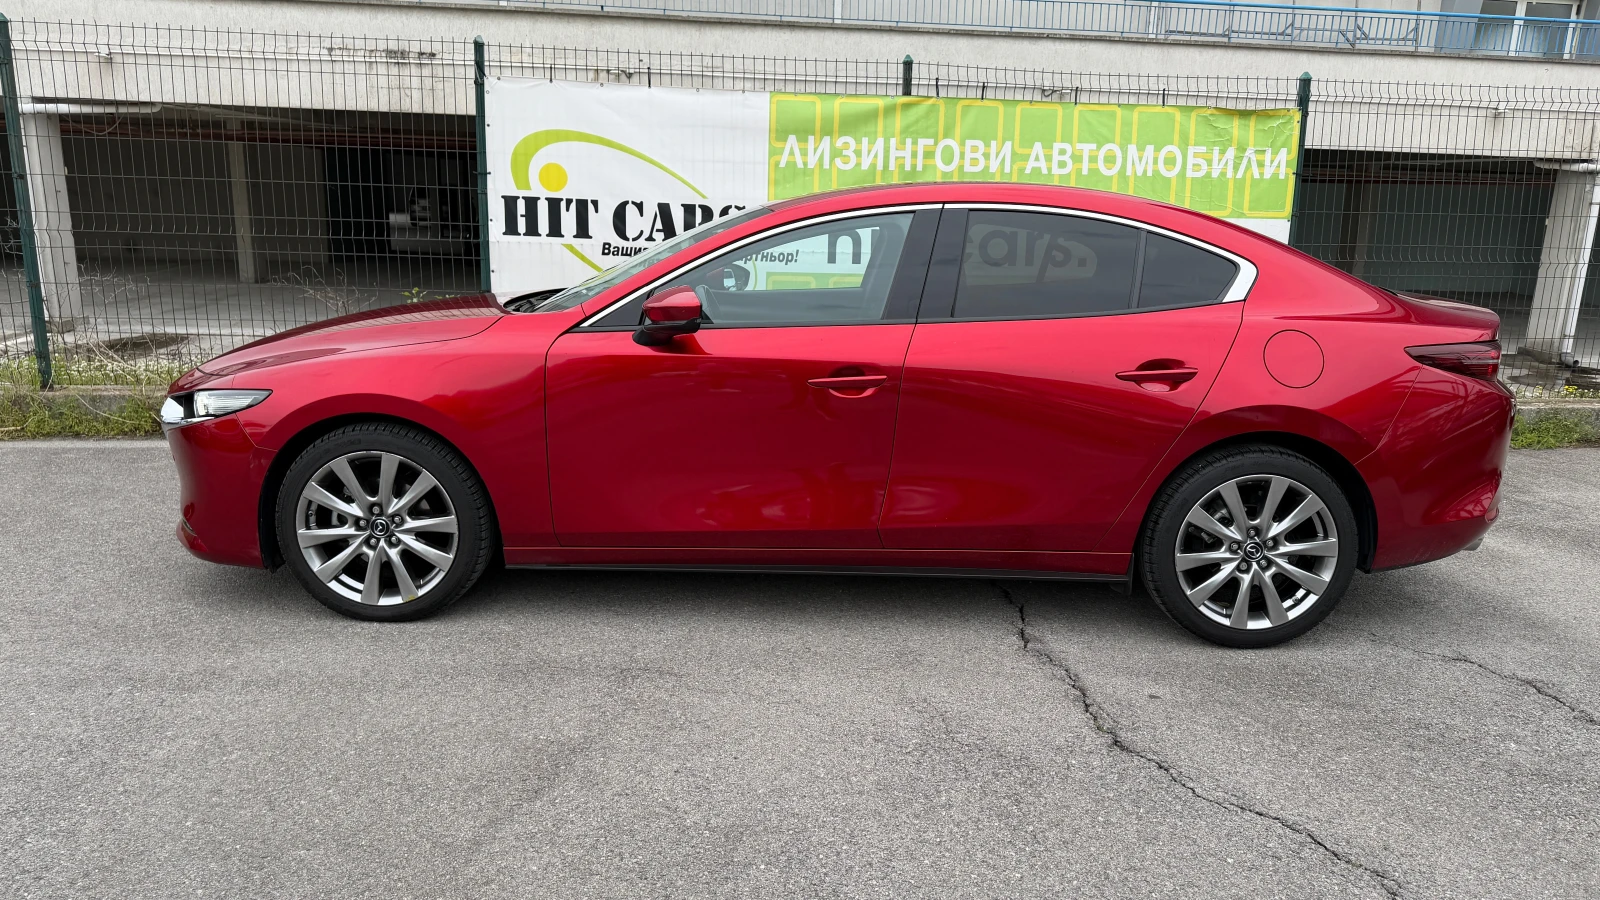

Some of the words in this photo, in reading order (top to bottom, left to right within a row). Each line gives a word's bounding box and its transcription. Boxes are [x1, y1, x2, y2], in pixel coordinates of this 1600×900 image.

[779, 134, 1012, 174] ЛИЗИНГОВИ
[1024, 141, 1288, 179] АВТОМОБИЛИ
[501, 195, 599, 239] HIT
